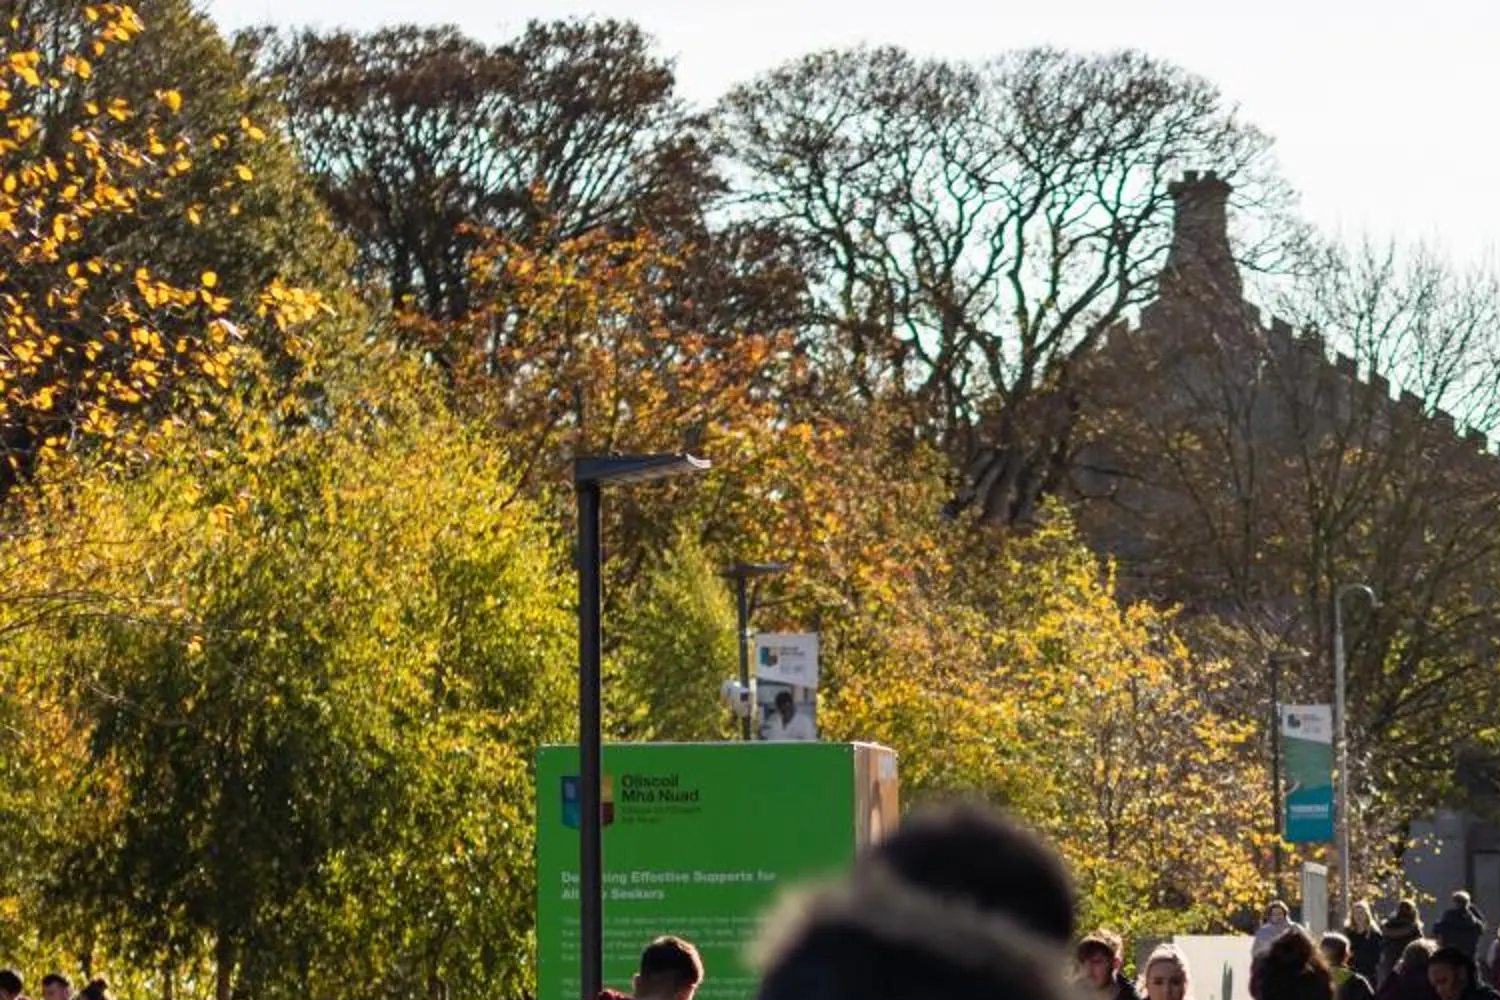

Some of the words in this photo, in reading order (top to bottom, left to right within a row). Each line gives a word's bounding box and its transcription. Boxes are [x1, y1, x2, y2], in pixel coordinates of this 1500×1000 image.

[631, 870, 690, 884] Effective
[693, 869, 753, 884] Supports
[757, 867, 776, 881] for
[611, 887, 665, 900] Seekers
